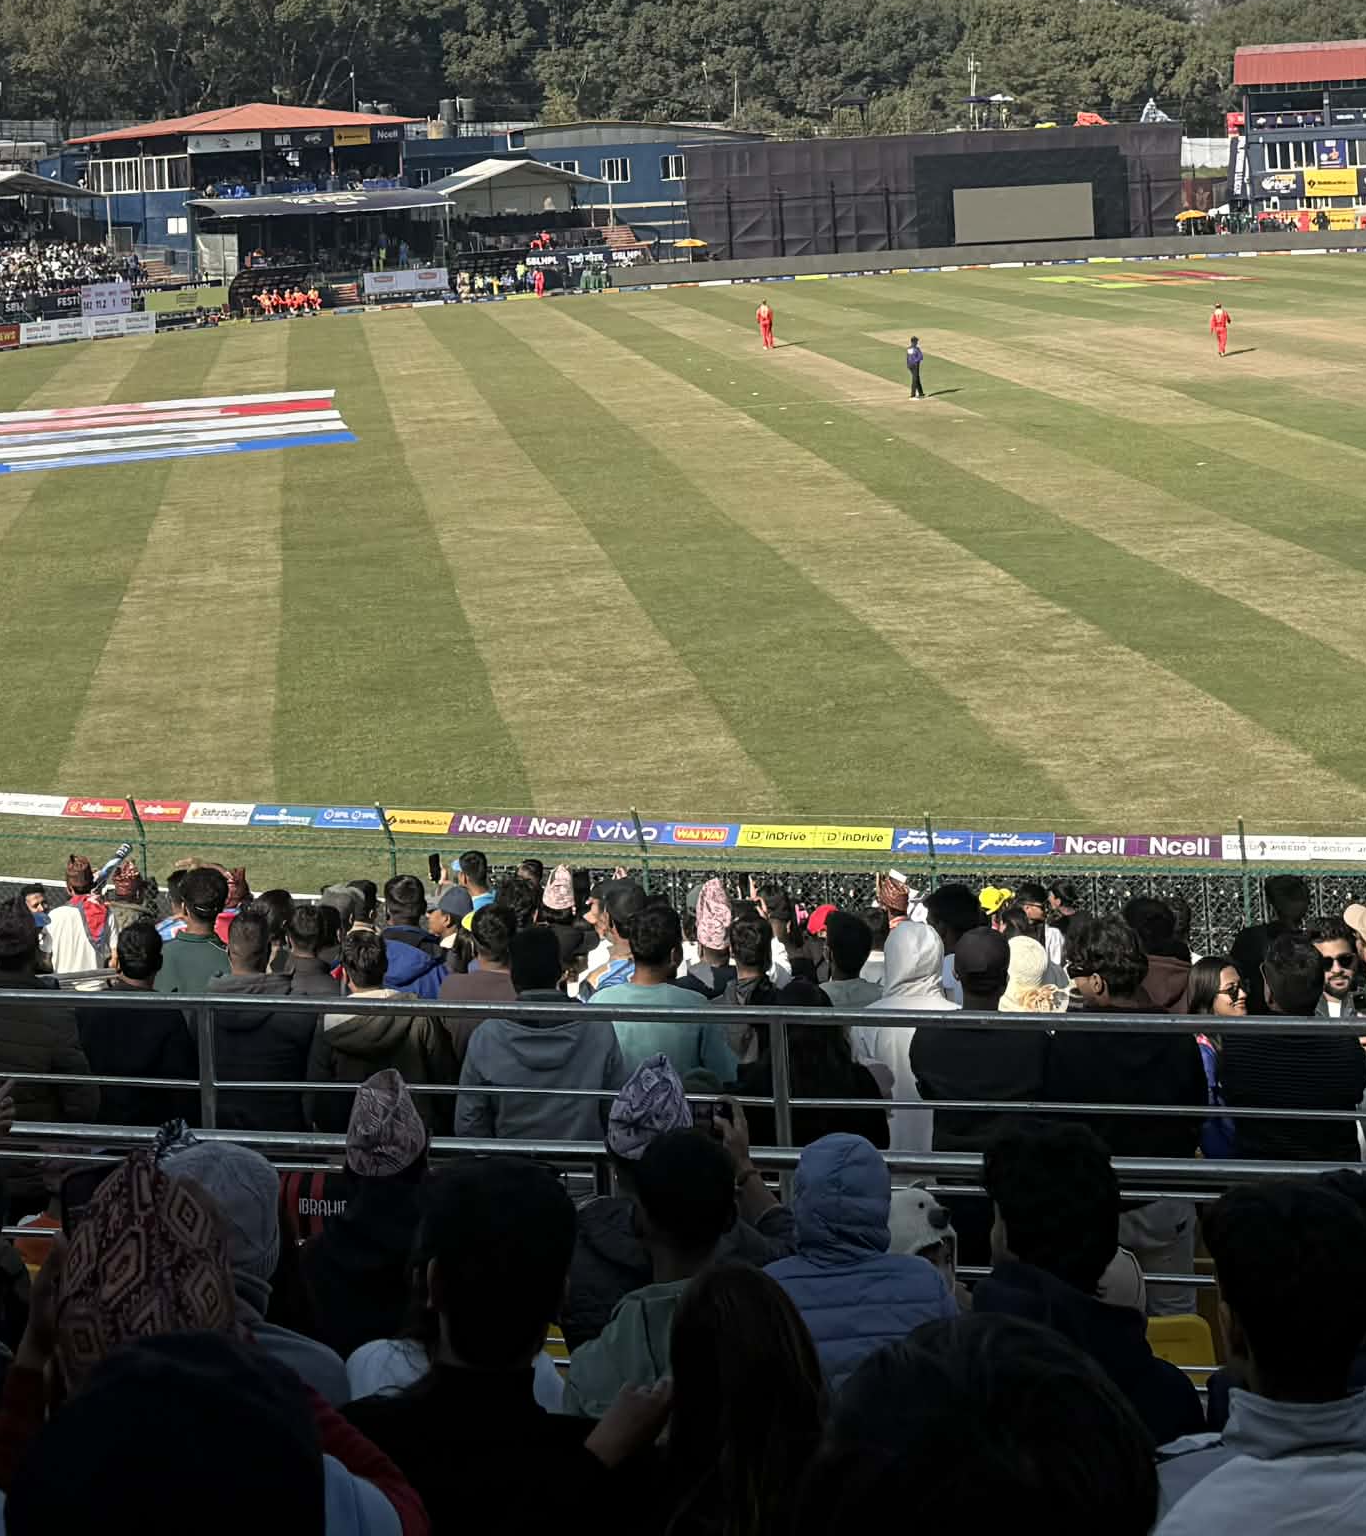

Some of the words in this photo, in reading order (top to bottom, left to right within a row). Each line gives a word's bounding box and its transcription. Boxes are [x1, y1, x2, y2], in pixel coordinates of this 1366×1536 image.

[57, 296, 81, 309] FESTI
[459, 815, 512, 834] Ncell
[528, 817, 582, 837] Ncell
[765, 831, 807, 842] inDrive
[842, 833, 884, 843] inDrive
[1065, 836, 1126, 855] Ncell
[1149, 837, 1211, 856] Ncell
